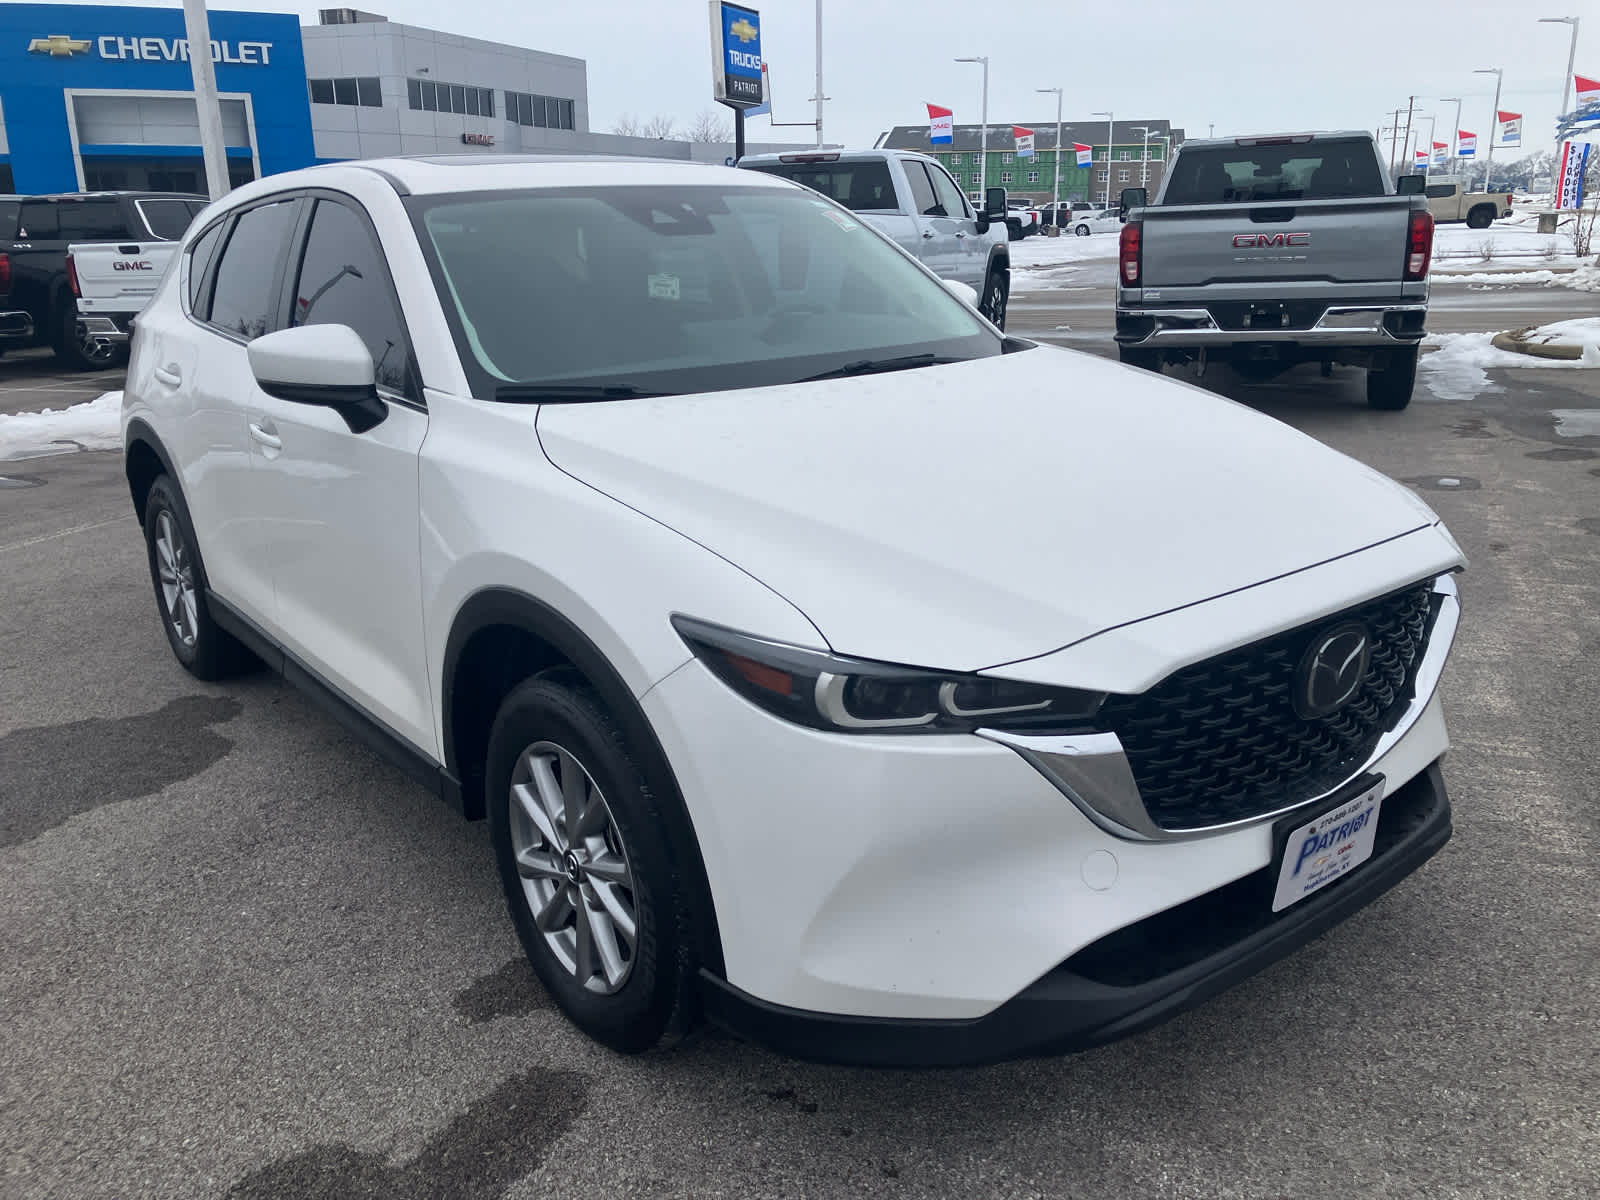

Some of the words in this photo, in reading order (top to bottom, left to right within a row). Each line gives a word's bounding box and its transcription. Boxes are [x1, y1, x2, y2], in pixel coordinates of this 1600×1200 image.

[98, 36, 272, 64] CHEVROLET
[729, 50, 761, 70] TRUCKS
[734, 80, 758, 95] PATRIOT
[1232, 232, 1311, 248] GMC
[113, 261, 153, 271] GMC
[1290, 806, 1374, 880] PATRIOT
